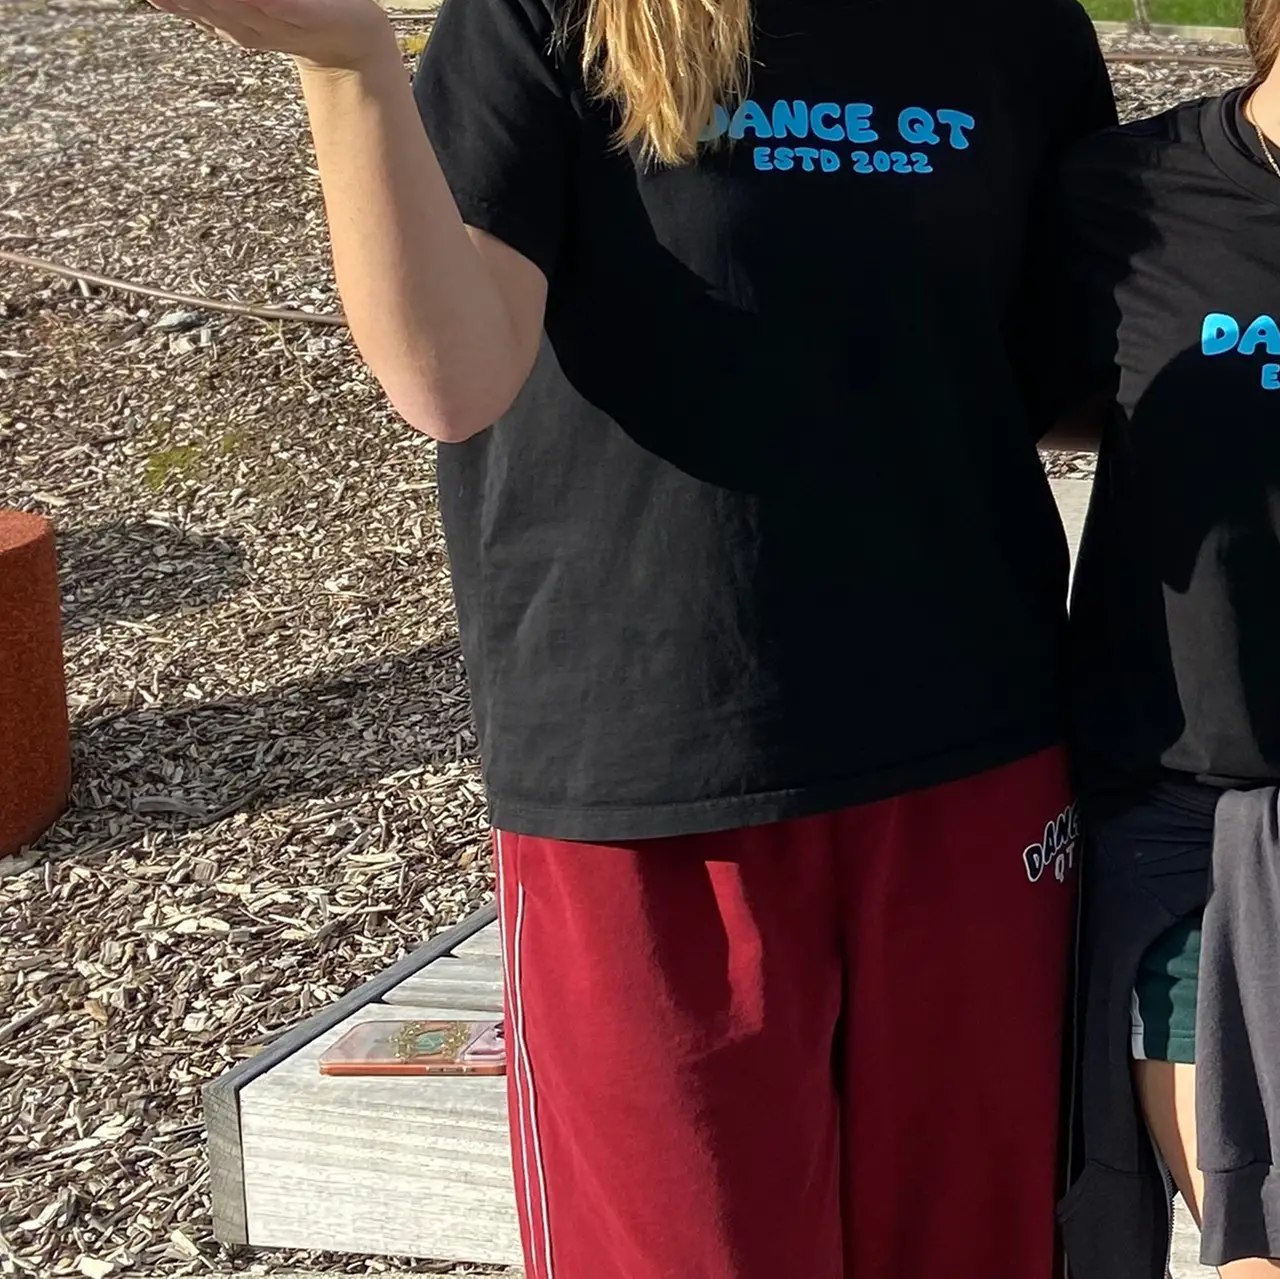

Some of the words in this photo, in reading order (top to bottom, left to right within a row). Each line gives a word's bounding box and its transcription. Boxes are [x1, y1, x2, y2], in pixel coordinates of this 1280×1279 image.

[897, 106, 975, 150] QT
[752, 146, 841, 172] ESTD
[851, 150, 934, 174] 2022
[1054, 841, 1075, 883] QT
